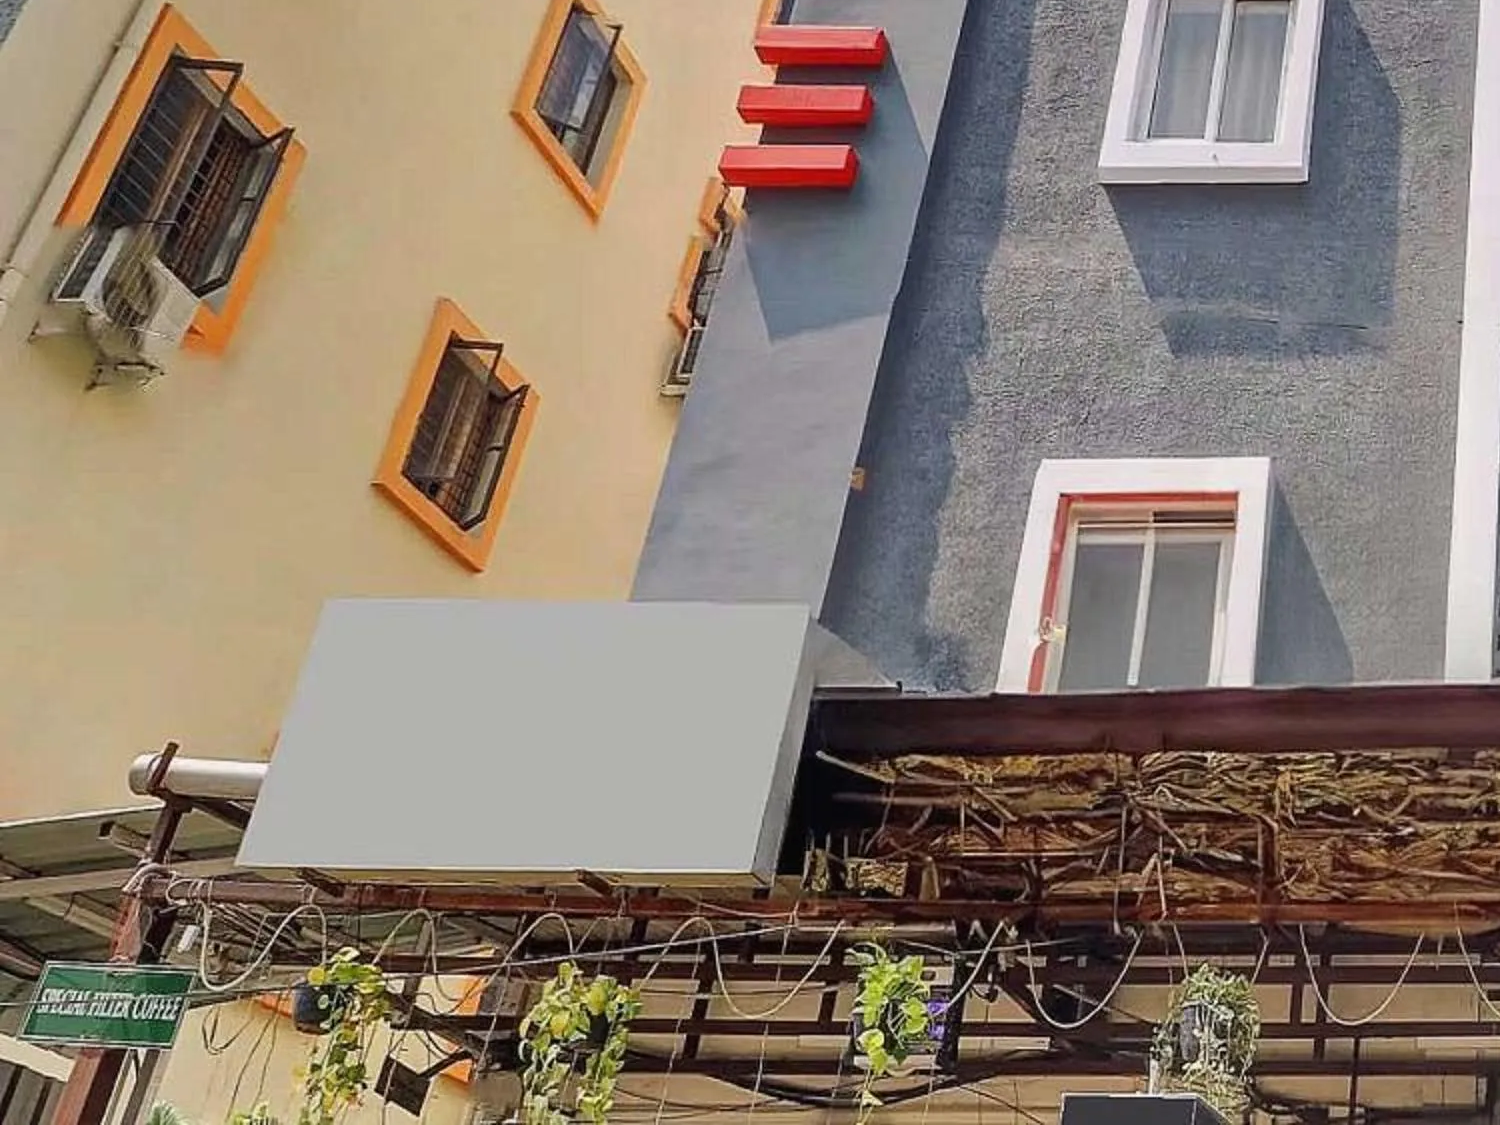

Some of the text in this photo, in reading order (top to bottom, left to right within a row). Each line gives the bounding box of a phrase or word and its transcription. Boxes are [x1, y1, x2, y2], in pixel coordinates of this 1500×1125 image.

[36, 988, 182, 1020] SPECIAL FILTER COFFEE
